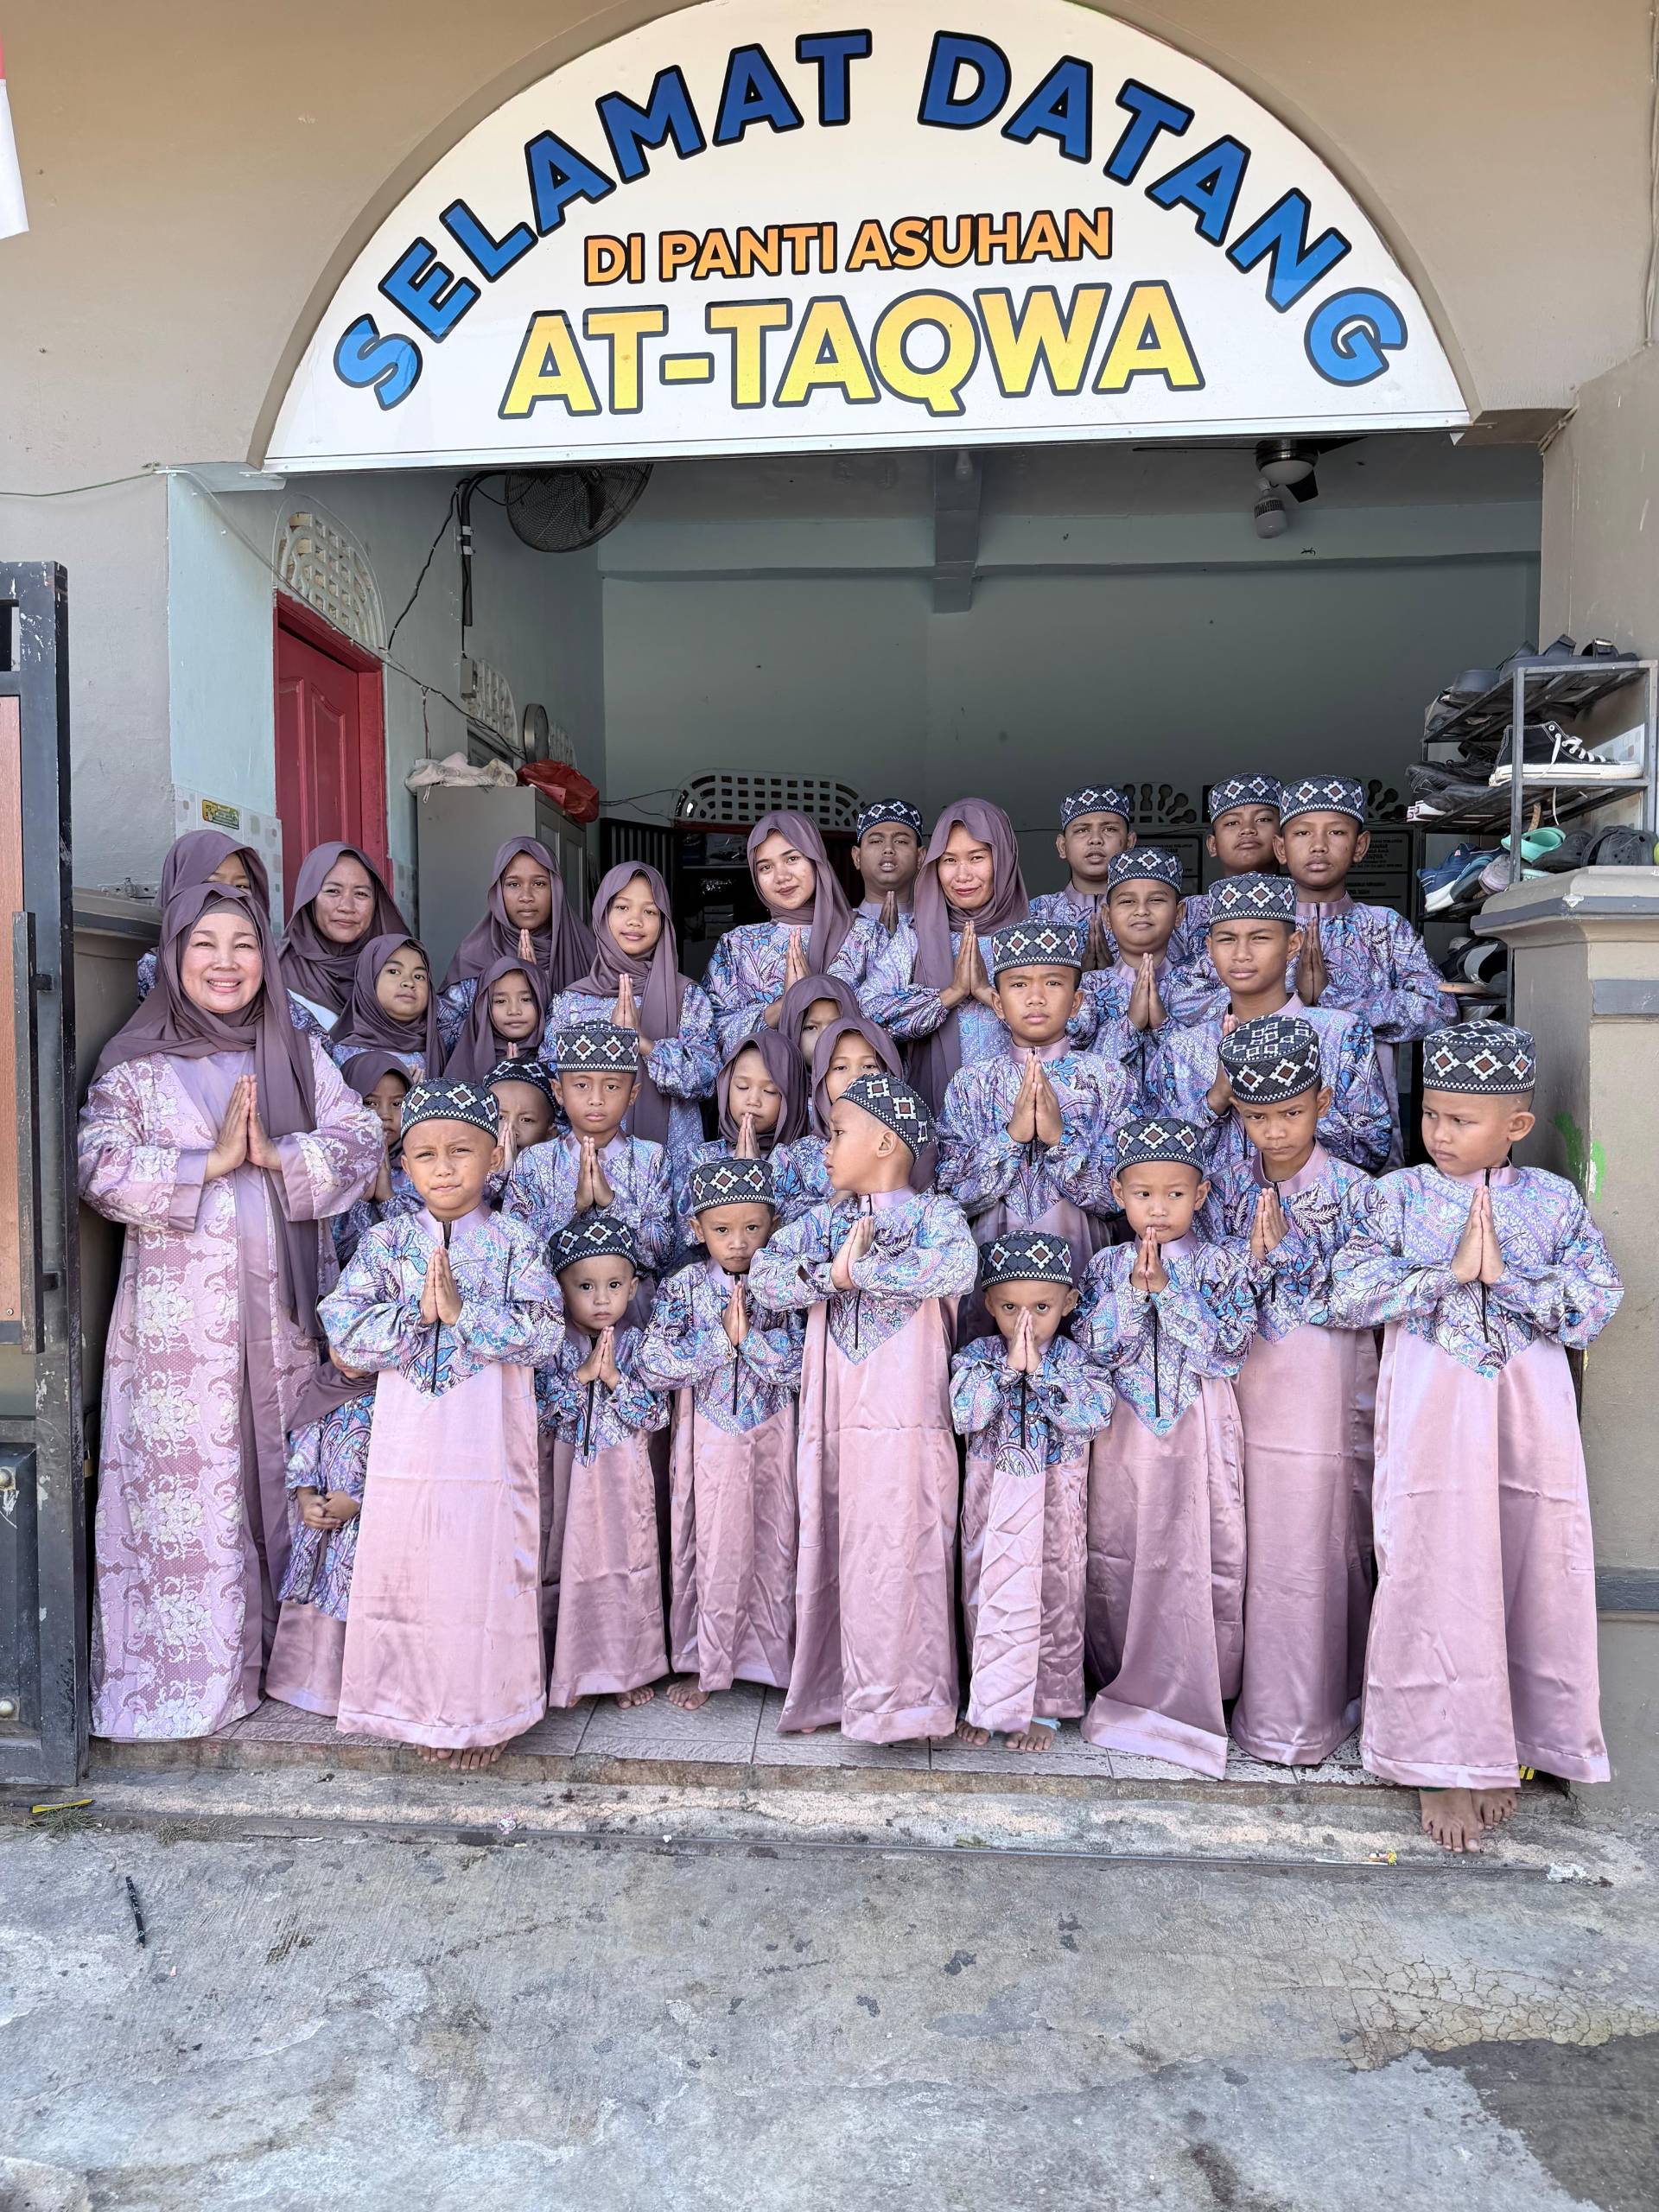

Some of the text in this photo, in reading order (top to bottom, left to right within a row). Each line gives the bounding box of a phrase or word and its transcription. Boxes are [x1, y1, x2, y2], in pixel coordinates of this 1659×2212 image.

[334, 29, 1408, 410] SELAMAT DATANG
[584, 207, 1113, 286] DI PANTI ASUHAN
[498, 280, 1205, 419] AT-TAQWA
